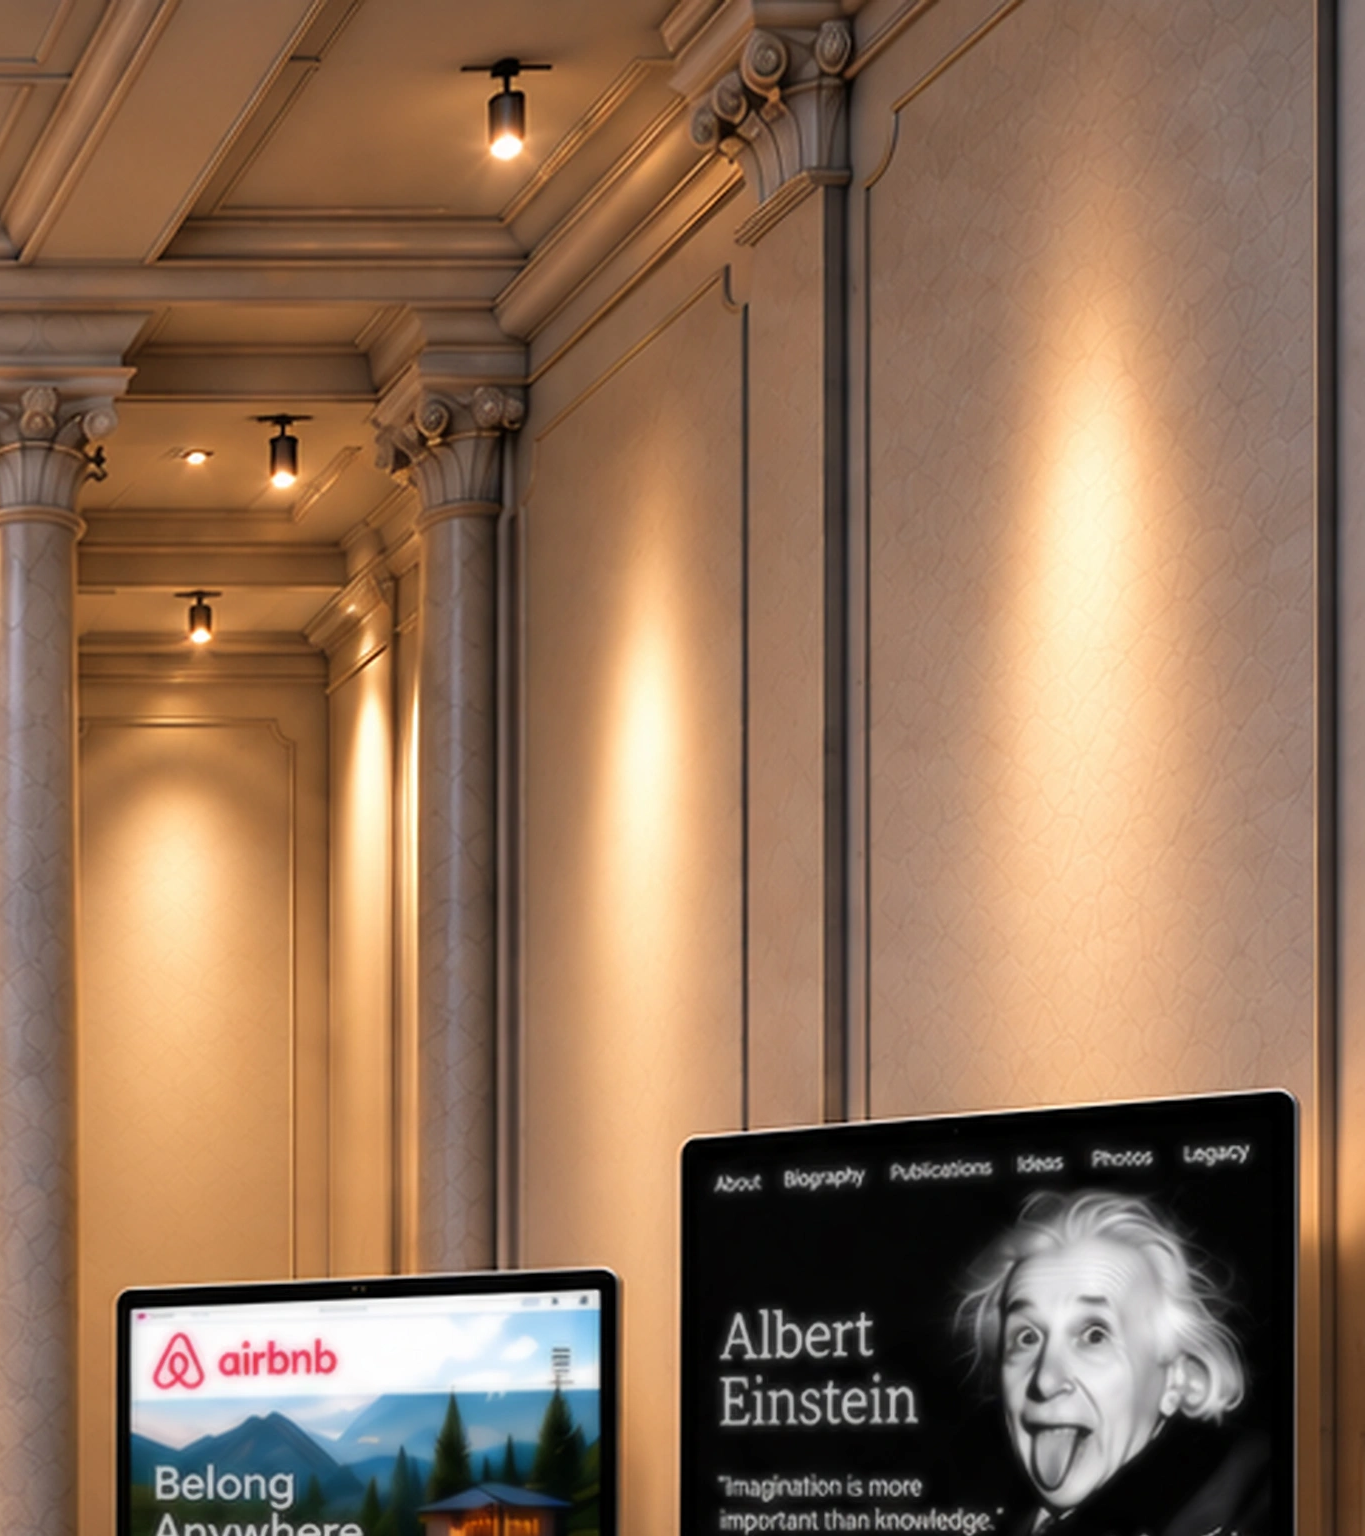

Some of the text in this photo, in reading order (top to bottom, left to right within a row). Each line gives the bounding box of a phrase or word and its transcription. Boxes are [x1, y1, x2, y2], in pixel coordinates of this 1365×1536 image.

[714, 1145, 1250, 1192] About Biography Publications Ideas Photos Legacy
[720, 1309, 873, 1360] Albert
[218, 1339, 337, 1377] airbnb
[720, 1373, 918, 1426] Einstein
[154, 1464, 295, 1510] Belong
[847, 1475, 864, 1497] is
[869, 1479, 922, 1497] more
[720, 1510, 819, 1535] important
[824, 1509, 870, 1530] than
